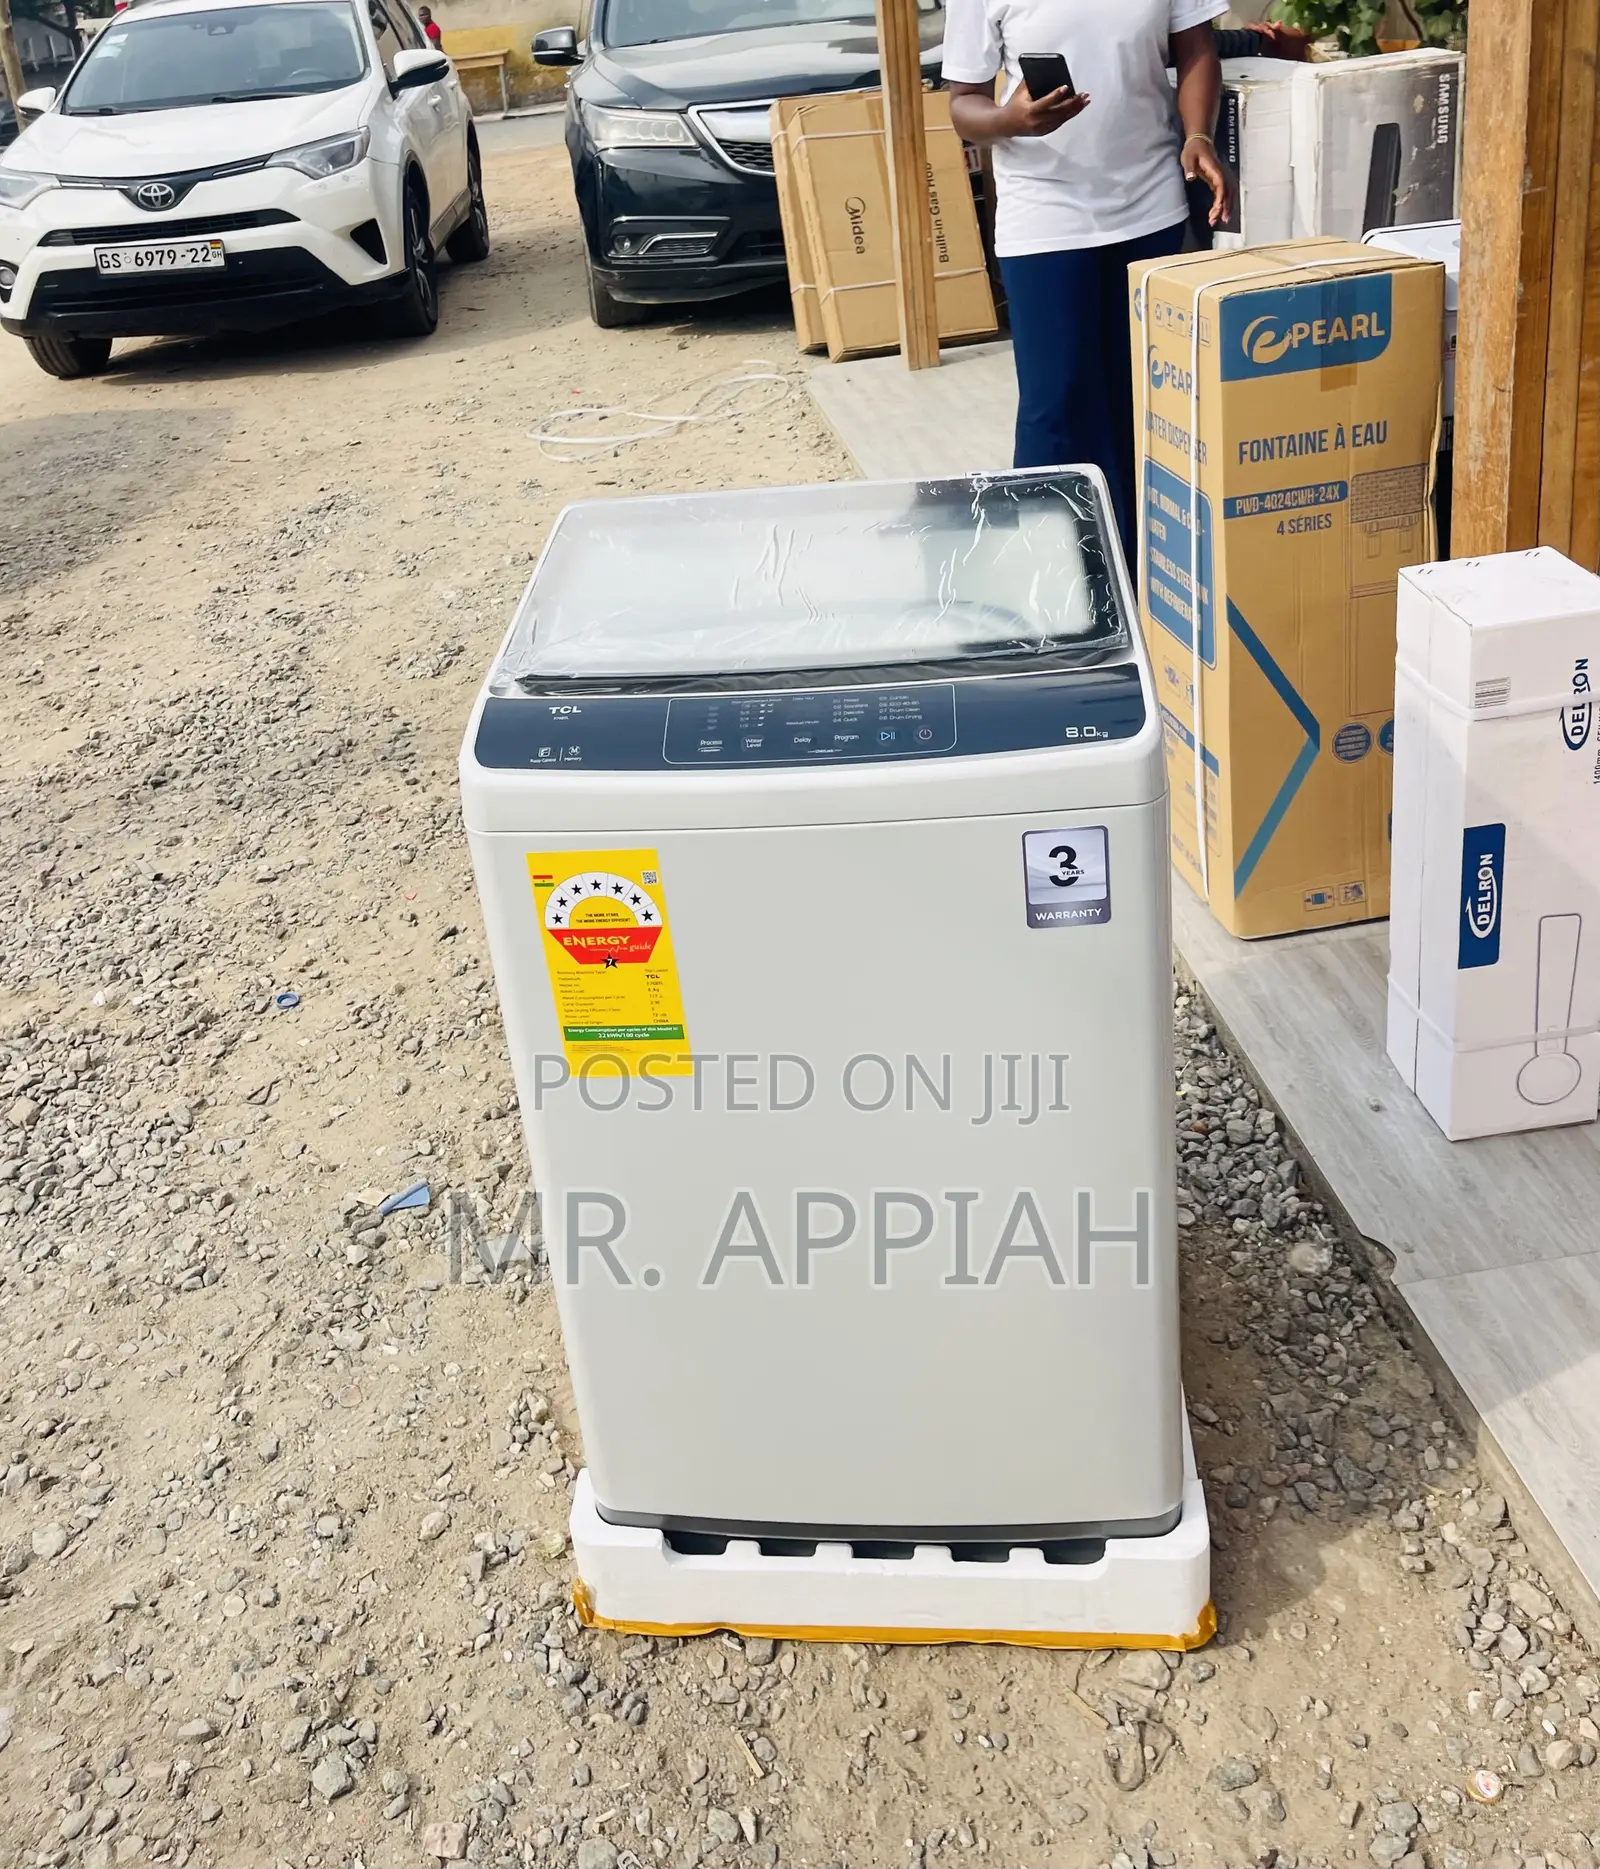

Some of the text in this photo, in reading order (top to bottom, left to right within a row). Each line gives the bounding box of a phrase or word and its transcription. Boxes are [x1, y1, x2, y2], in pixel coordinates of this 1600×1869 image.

[1437, 73, 1450, 144] SAMSUNG
[1228, 98, 1236, 163] SAMSUNG
[928, 191, 940, 215] Gas
[845, 196, 866, 254] Midea
[933, 219, 949, 263] Built-in
[99, 253, 122, 269] GS
[211, 250, 222, 259] GH
[1291, 311, 1385, 349] PEARL
[1163, 361, 1193, 396] PEAR
[1238, 420, 1388, 465] FONTAINE À EAU
[1276, 513, 1332, 536] 4 SÉRIES
[549, 705, 582, 714] TCL
[834, 734, 859, 742] Program
[1048, 845, 1079, 887] 3
[1477, 853, 1493, 925] DELRON
[1035, 908, 1102, 921] WARRANTY
[562, 934, 630, 949] ENERGY
[629, 941, 652, 952] guide
[607, 958, 613, 966] 7
